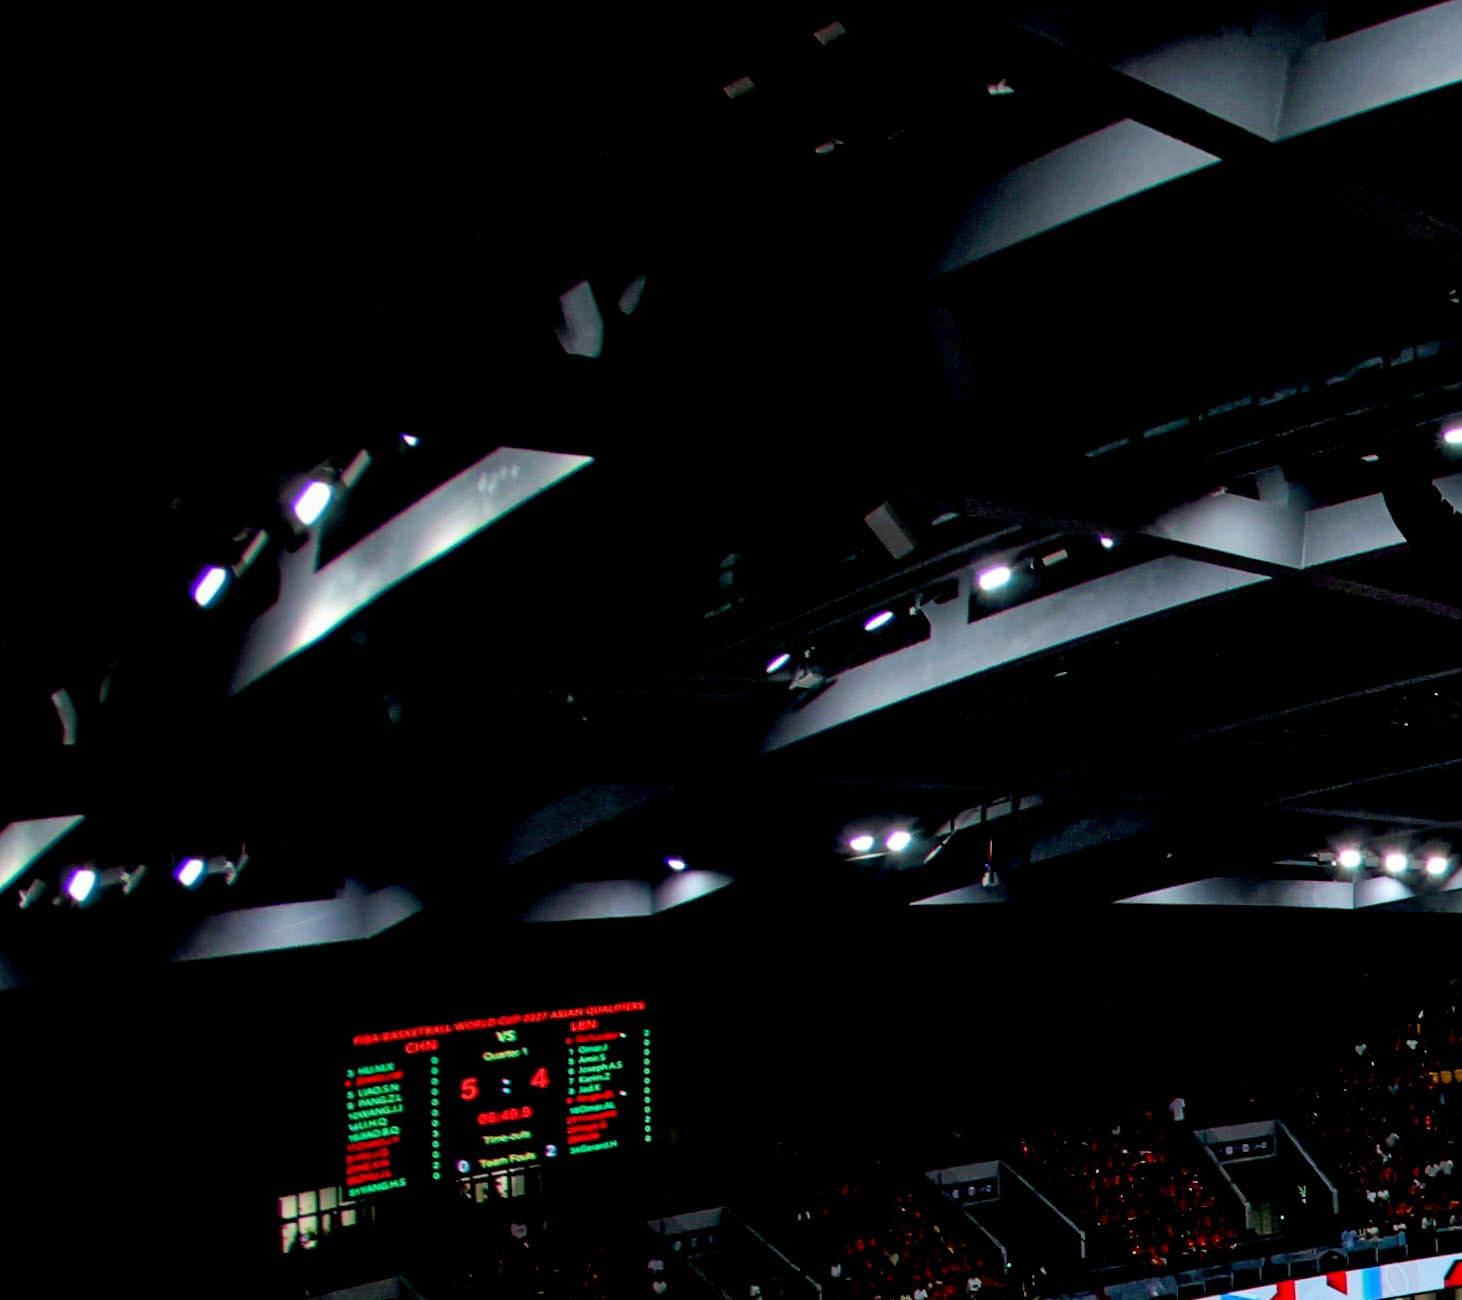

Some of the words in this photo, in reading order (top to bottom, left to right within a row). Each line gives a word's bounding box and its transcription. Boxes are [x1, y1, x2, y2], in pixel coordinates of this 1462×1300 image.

[382, 1025, 451, 1042] BASKETBALL
[454, 1017, 496, 1031] WORLD
[498, 1014, 521, 1026] CUP
[550, 1006, 584, 1019] ASIAN
[586, 1000, 646, 1016] QUALIFIERS
[570, 1018, 598, 1032] LBN
[495, 1030, 517, 1043] VS
[405, 1039, 439, 1054] CHN
[482, 1049, 521, 1062] Quarter
[529, 1066, 551, 1089] 4
[461, 1077, 479, 1101] 5
[545, 1144, 558, 1157] 2
[457, 1160, 471, 1173] 0
[479, 1158, 509, 1168] Team
[508, 1151, 538, 1163] Fouls
